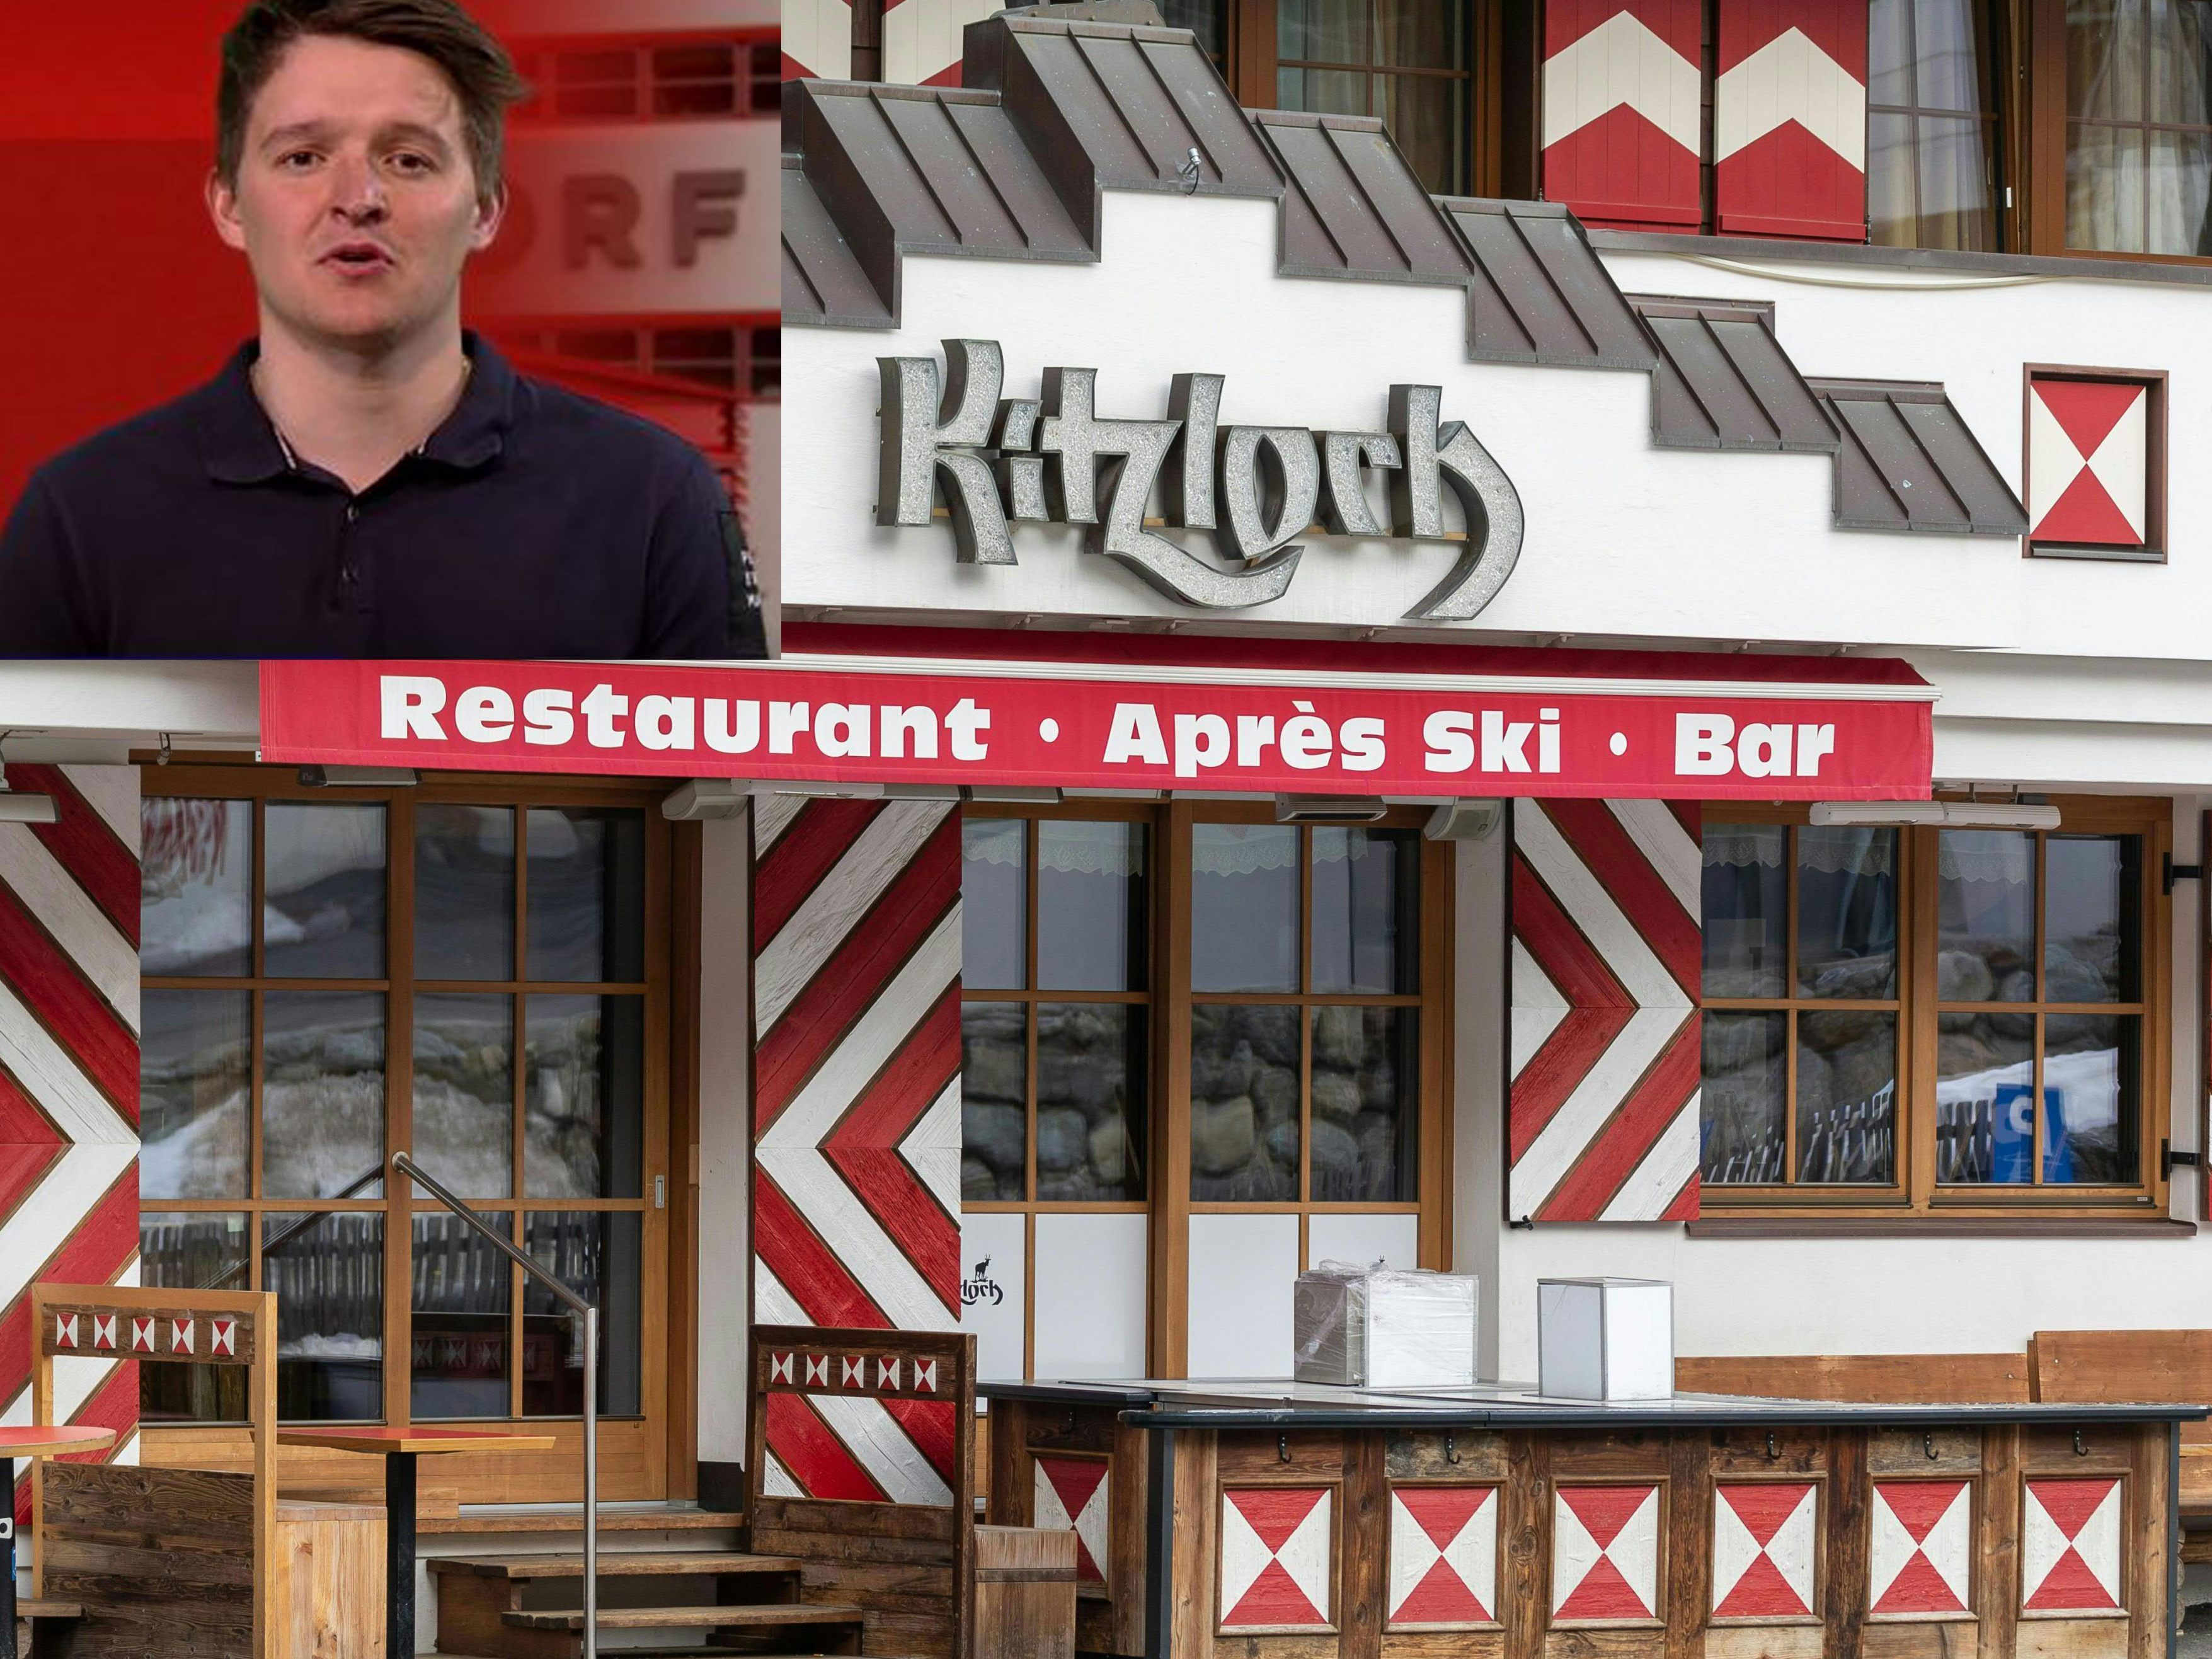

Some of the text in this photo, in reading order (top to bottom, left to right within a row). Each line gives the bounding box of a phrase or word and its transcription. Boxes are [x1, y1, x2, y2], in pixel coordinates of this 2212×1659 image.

[876, 339, 1525, 621] Kitzloch
[380, 675, 1835, 778] Restaurant Après Ski Bar
[960, 1279, 1003, 1306] loch
